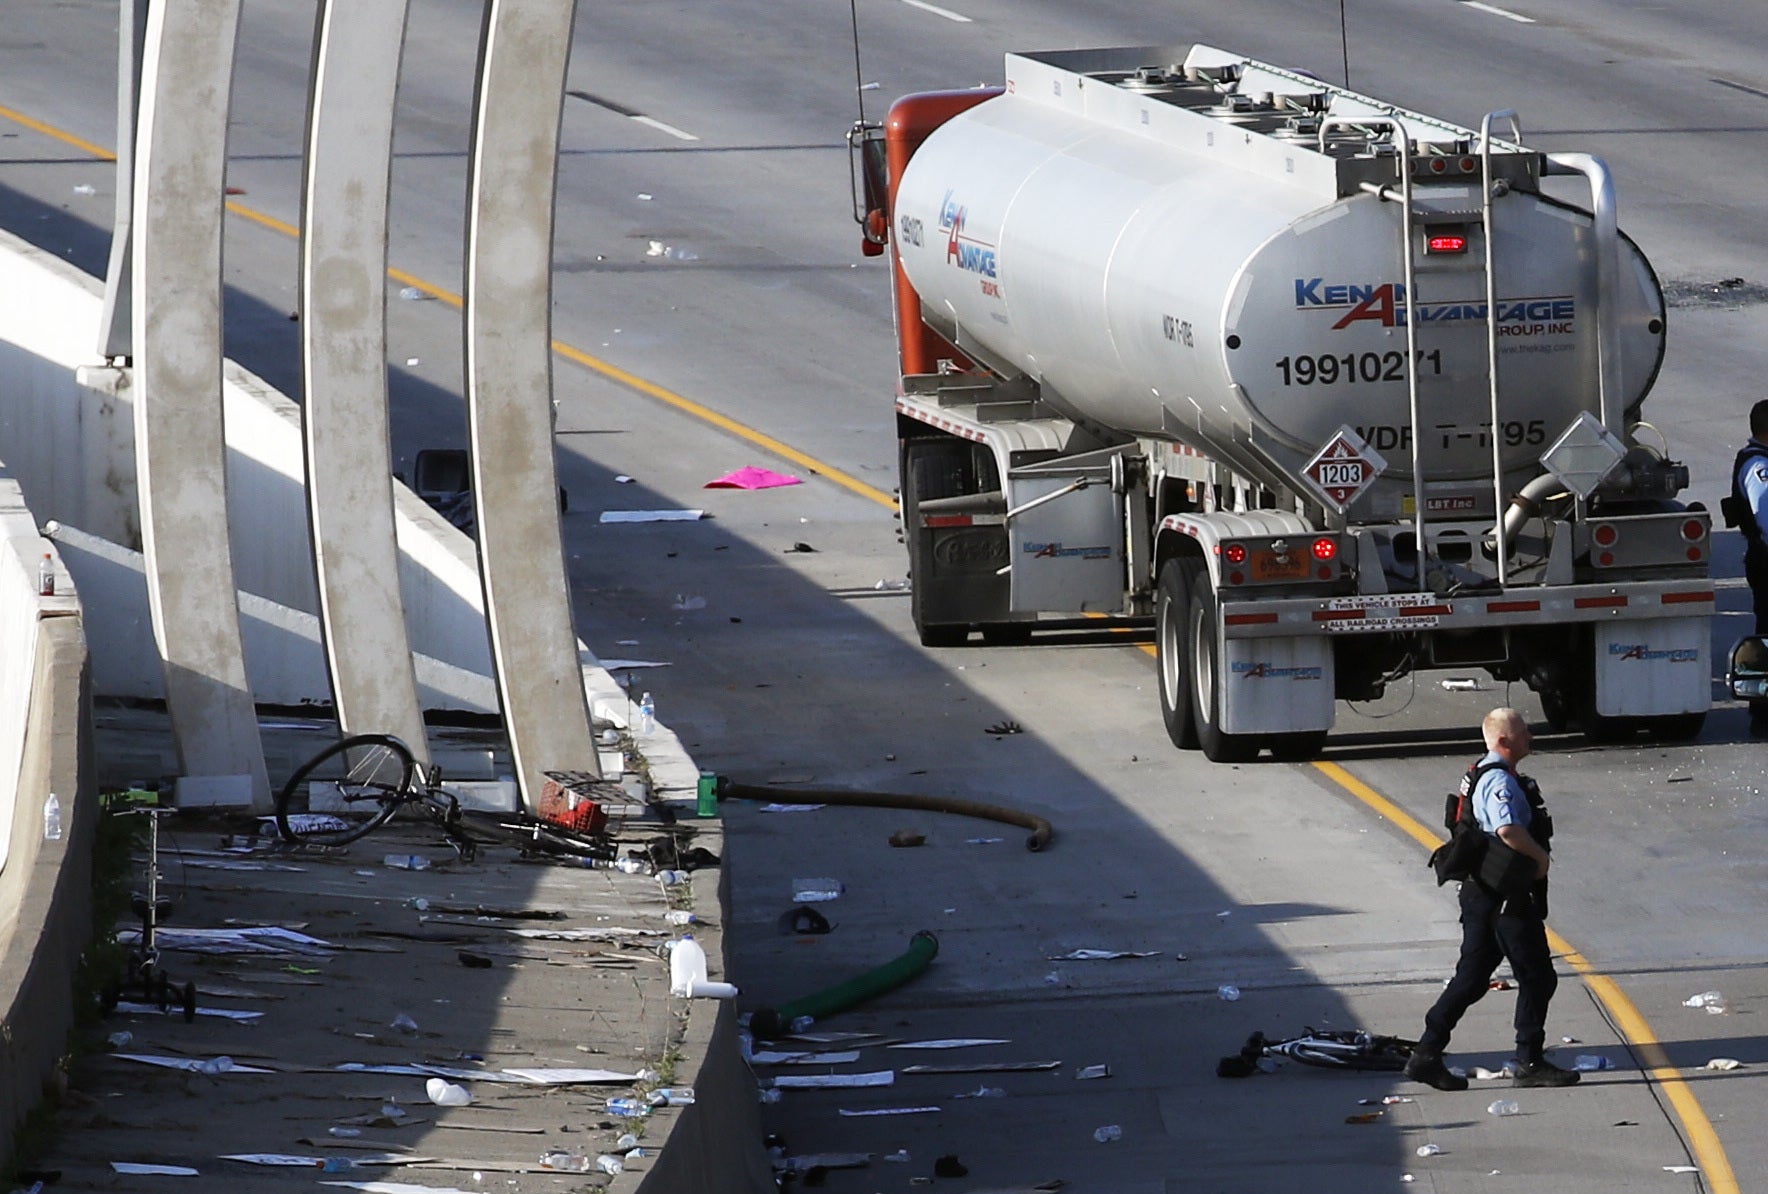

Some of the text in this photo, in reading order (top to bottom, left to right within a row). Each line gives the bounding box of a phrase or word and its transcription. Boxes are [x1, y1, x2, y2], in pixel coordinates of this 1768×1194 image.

[1295, 278, 1418, 318] KENAN
[1498, 324, 1546, 337] ROUP,
[1276, 349, 1442, 386] 19910271
[1321, 464, 1361, 484] 1203
[1338, 490, 1345, 498] 3
[1356, 601, 1389, 609] VEHICLE
[1390, 616, 1436, 625] CROSSINGS
